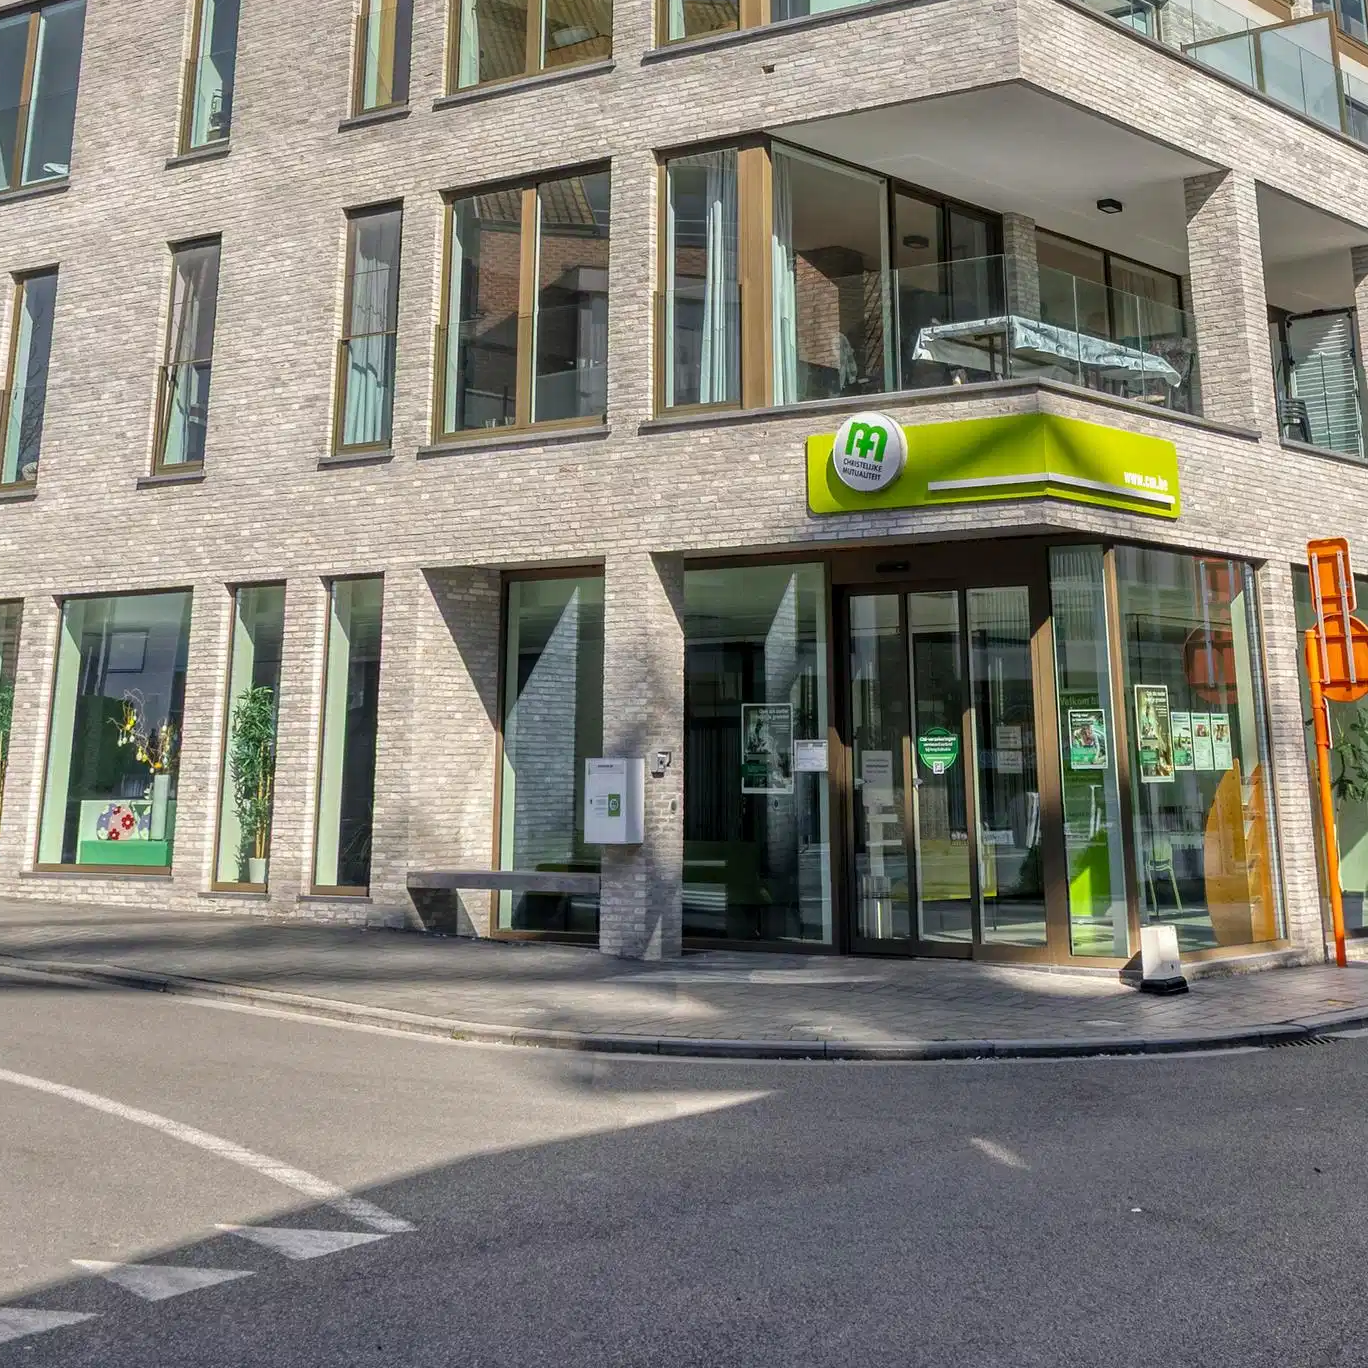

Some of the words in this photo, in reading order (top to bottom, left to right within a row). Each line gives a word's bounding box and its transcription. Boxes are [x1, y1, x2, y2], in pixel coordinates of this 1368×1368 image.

[843, 458, 883, 472] CHRISTELIJKE
[842, 467, 881, 481] MUTUALITEIT
[1124, 471, 1169, 491] www.cm.be
